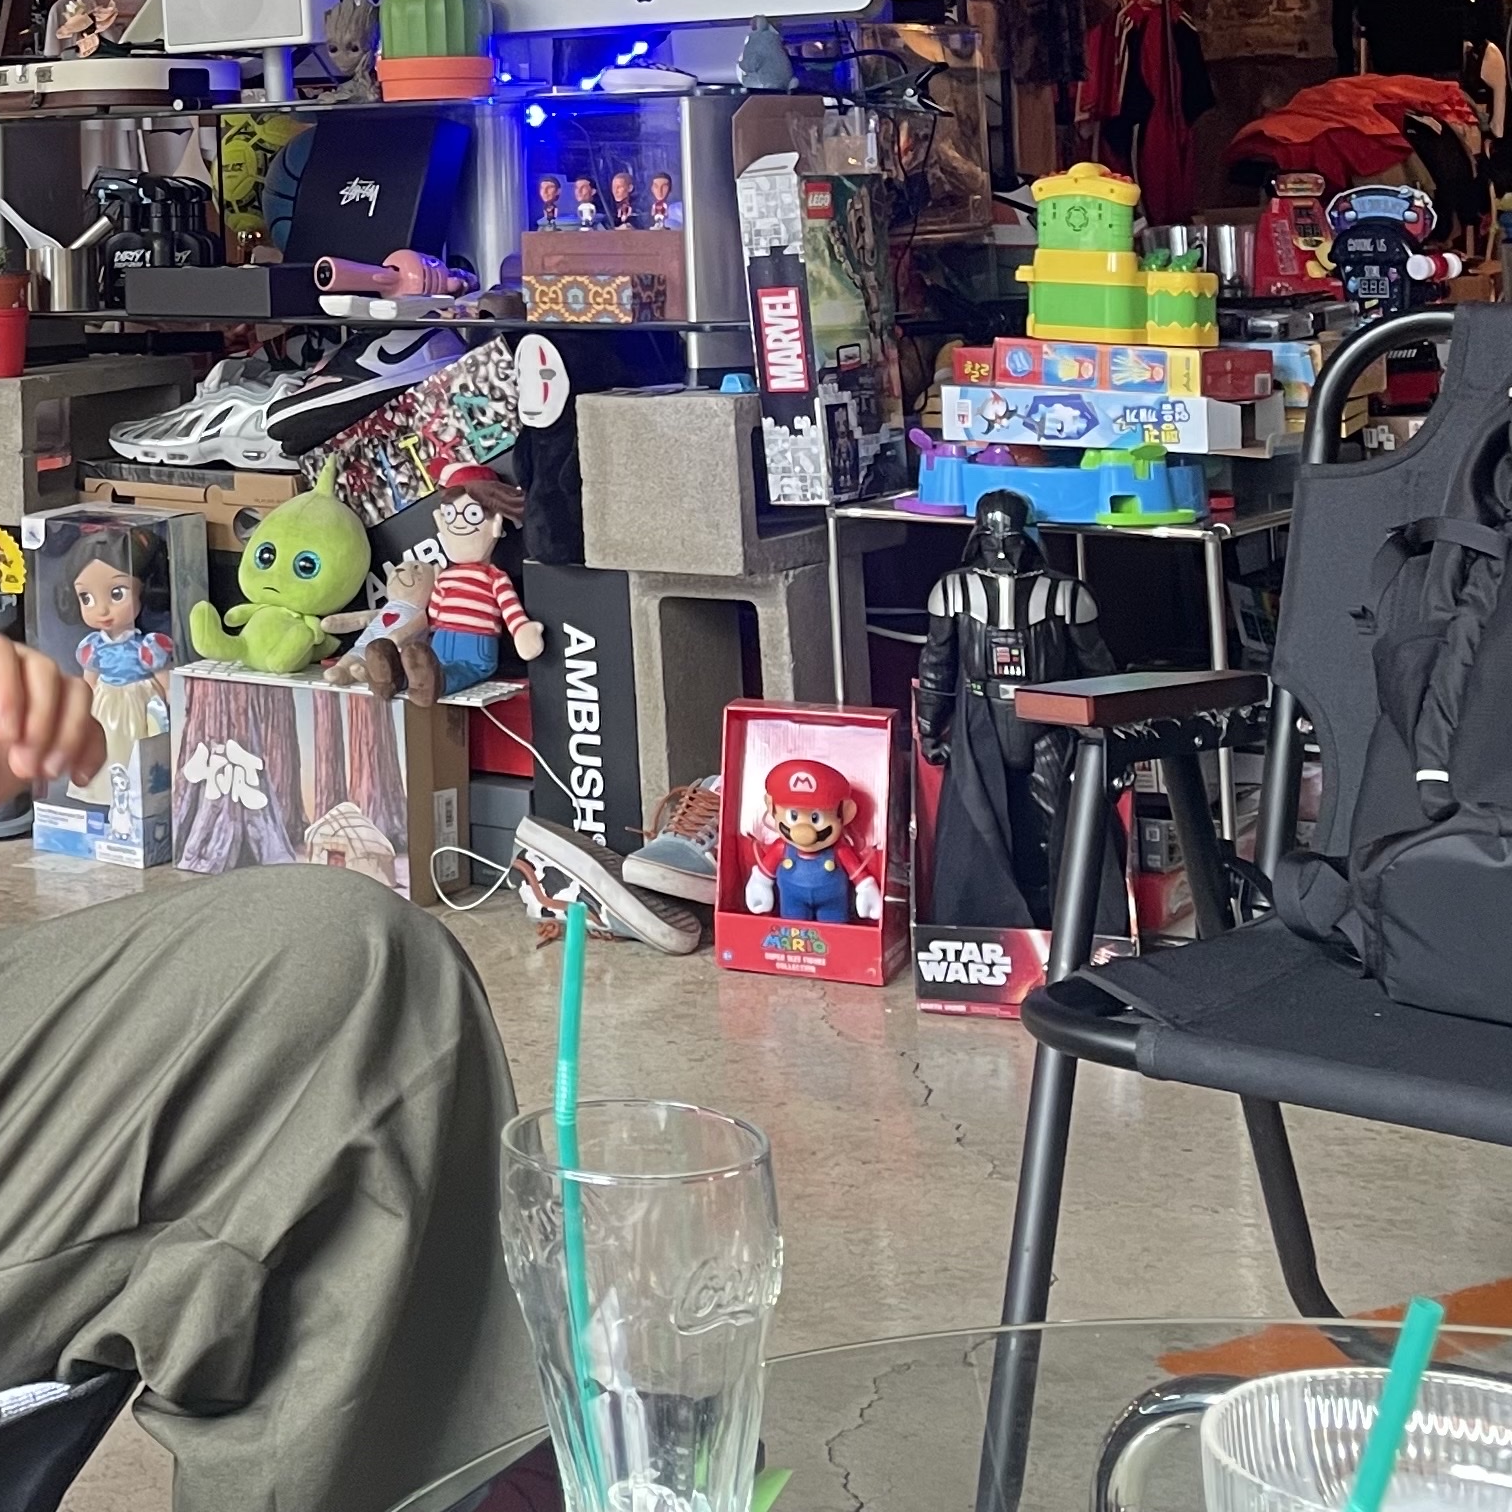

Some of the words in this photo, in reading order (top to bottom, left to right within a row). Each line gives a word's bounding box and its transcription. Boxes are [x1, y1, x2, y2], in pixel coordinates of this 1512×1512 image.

[807, 191, 832, 207] LEGO
[761, 289, 806, 390] MARVEL
[562, 622, 606, 834] AMBUSH
[793, 775, 813, 790] M
[770, 925, 819, 938] SUPER
[761, 934, 829, 956] MARIO
[917, 940, 1012, 963] STAR
[918, 961, 1012, 986] WARS
